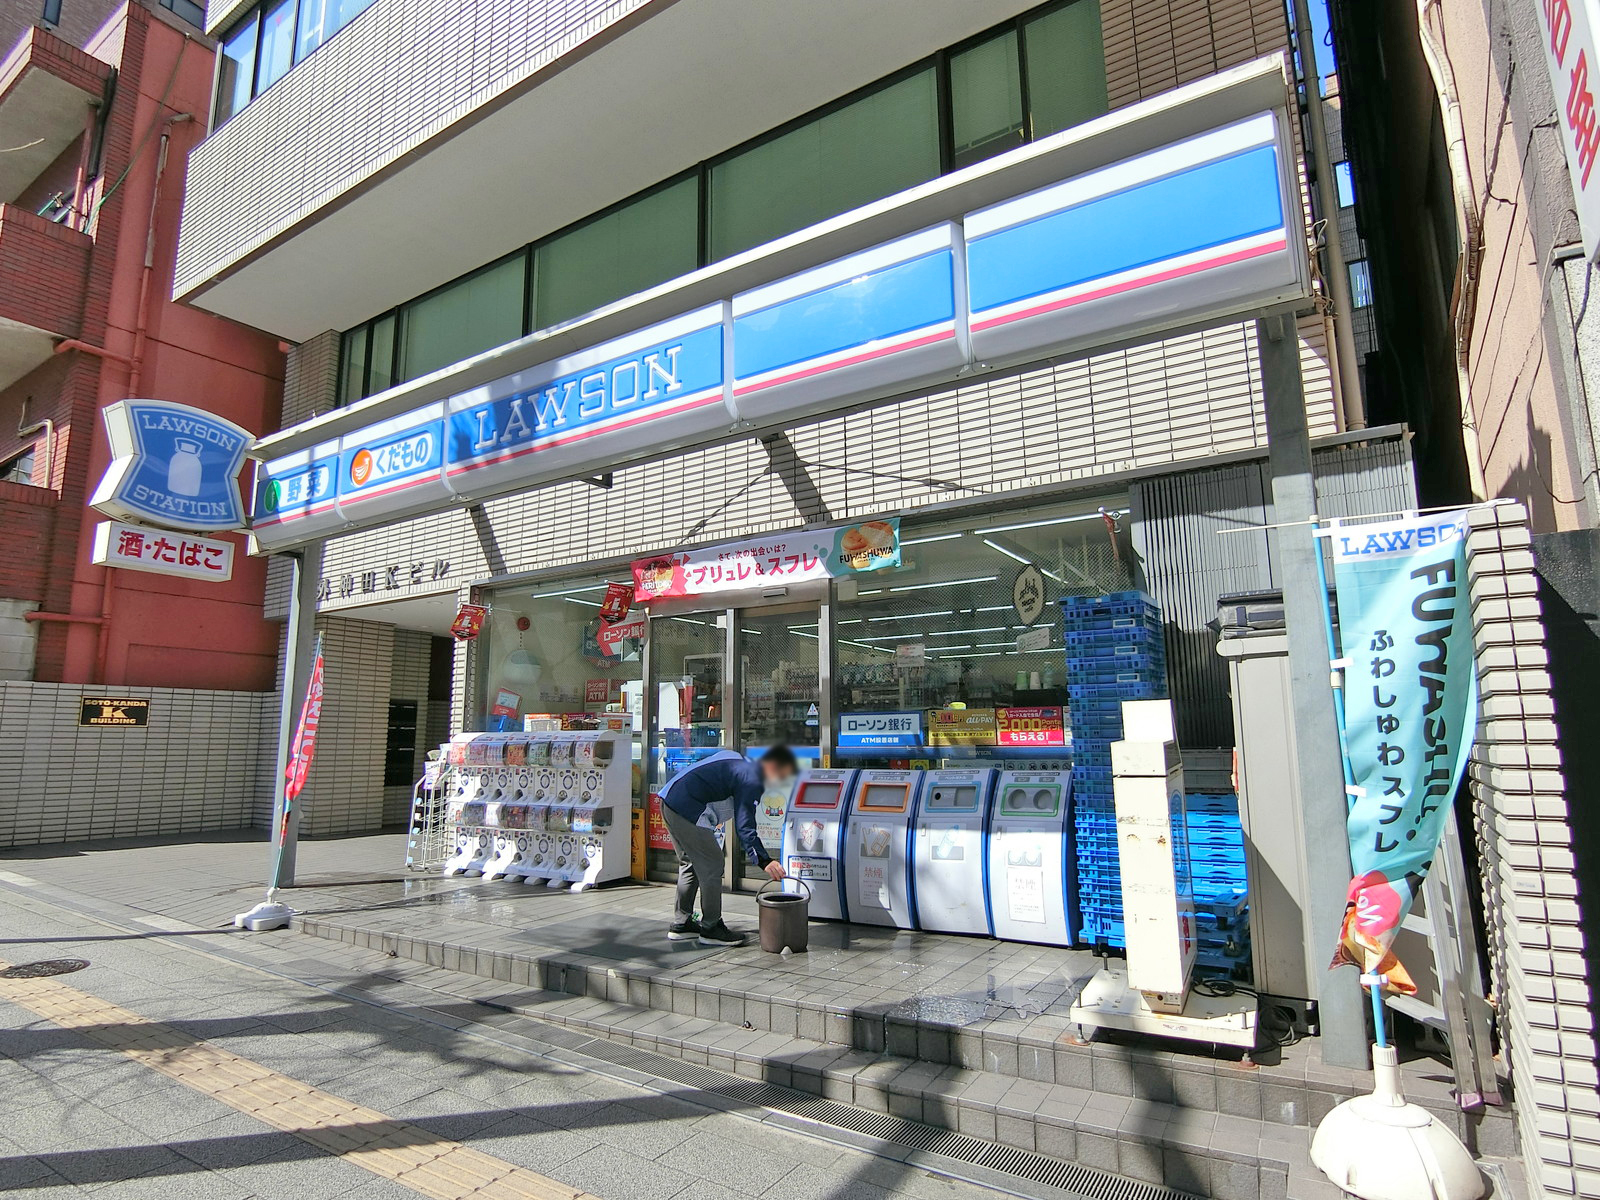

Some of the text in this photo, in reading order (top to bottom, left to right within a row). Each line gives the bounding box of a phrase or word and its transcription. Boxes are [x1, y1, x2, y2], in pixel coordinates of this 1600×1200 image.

[474, 344, 682, 450] LAWSON
[142, 415, 237, 451] LAWSON
[376, 437, 429, 474] くだもの
[133, 484, 228, 516] STATION
[287, 469, 322, 502] 野菜
[117, 530, 224, 571] 酒・たばこ
[839, 545, 894, 564] FUWASHUWA
[693, 552, 818, 585] ブリュレ & スフレ
[84, 699, 147, 707] SOTO-KANDA
[587, 691, 606, 701] ATM
[100, 706, 129, 719] K
[847, 718, 912, 731] ローソン銀行
[998, 718, 1041, 732] 2,000
[1369, 629, 1405, 853] ふわしゅわスフレ
